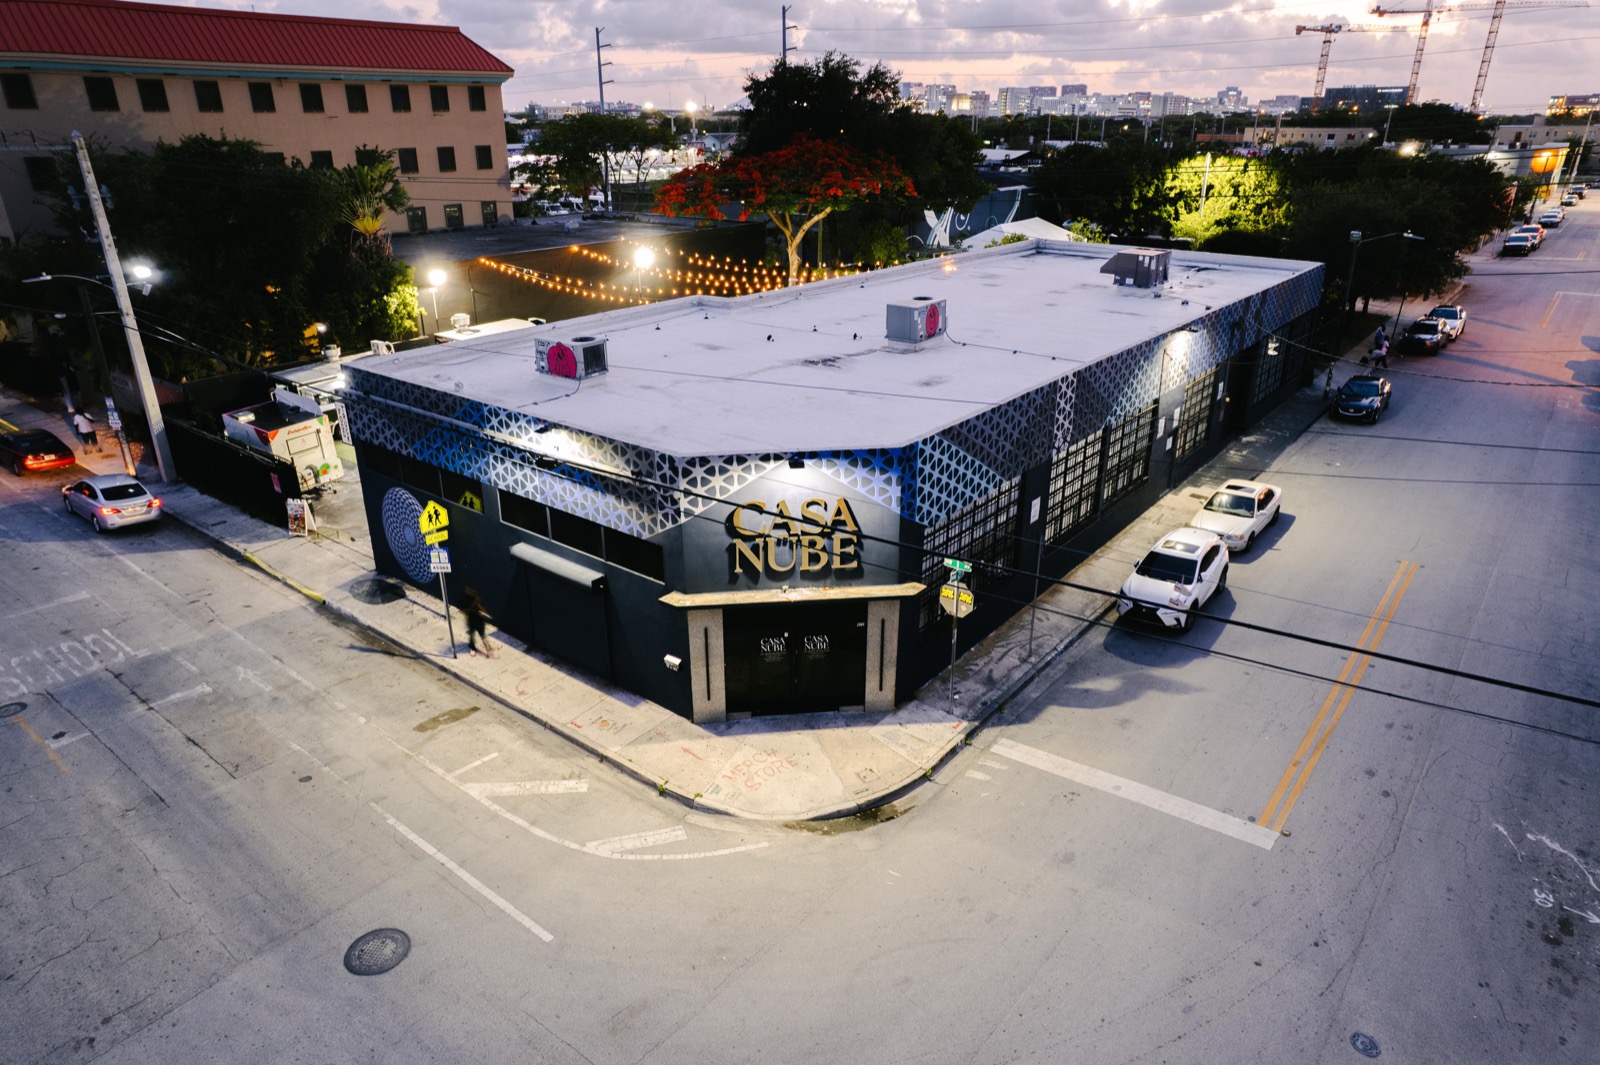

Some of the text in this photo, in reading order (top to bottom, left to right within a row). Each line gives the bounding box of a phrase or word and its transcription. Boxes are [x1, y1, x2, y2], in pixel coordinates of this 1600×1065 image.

[733, 497, 858, 536] CASA
[428, 533, 446, 542] SCHOOL
[760, 637, 786, 646] CASA
[804, 635, 829, 643] CASA
[0, 628, 152, 697] SCHOOL
[722, 747, 778, 782] MERCH
[744, 756, 799, 790] STORE
